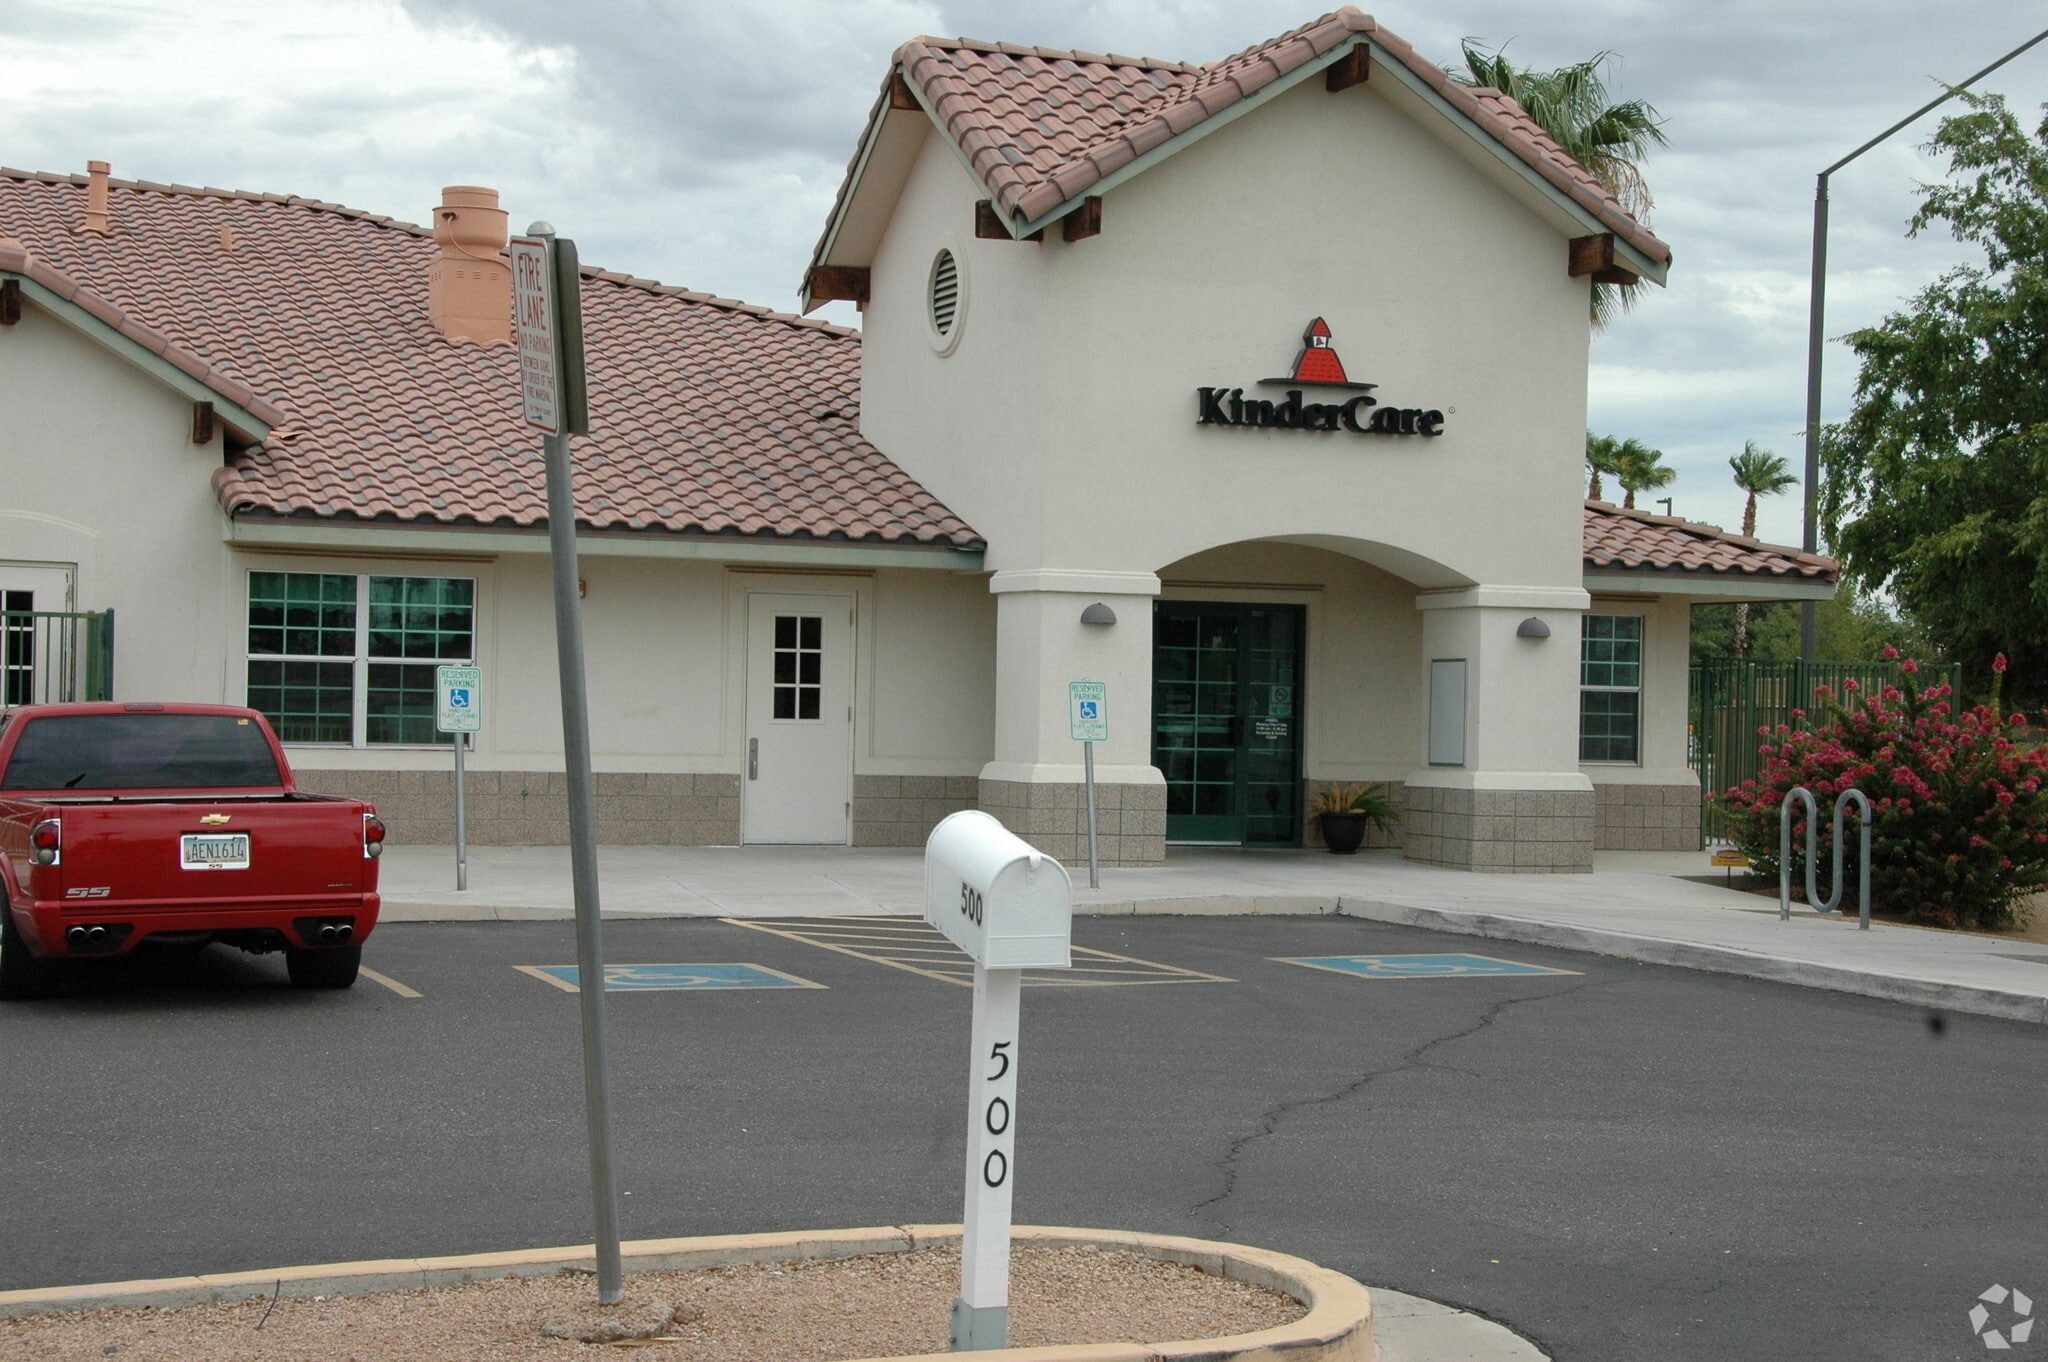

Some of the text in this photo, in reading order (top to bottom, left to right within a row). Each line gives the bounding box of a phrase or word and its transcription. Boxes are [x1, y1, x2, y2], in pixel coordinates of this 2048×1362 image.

[518, 255, 542, 291] FIRE
[520, 293, 546, 330] LANE
[520, 333, 551, 355] NO PARKING
[1196, 387, 1444, 436] KinderCare
[441, 670, 478, 679] RESERVED
[444, 679, 475, 688] PARKING
[1071, 685, 1104, 693] RESERVED
[1074, 693, 1102, 701] PARKING
[192, 843, 244, 859] AEN1614
[961, 882, 983, 927] 500
[983, 1041, 1011, 1188] 500
